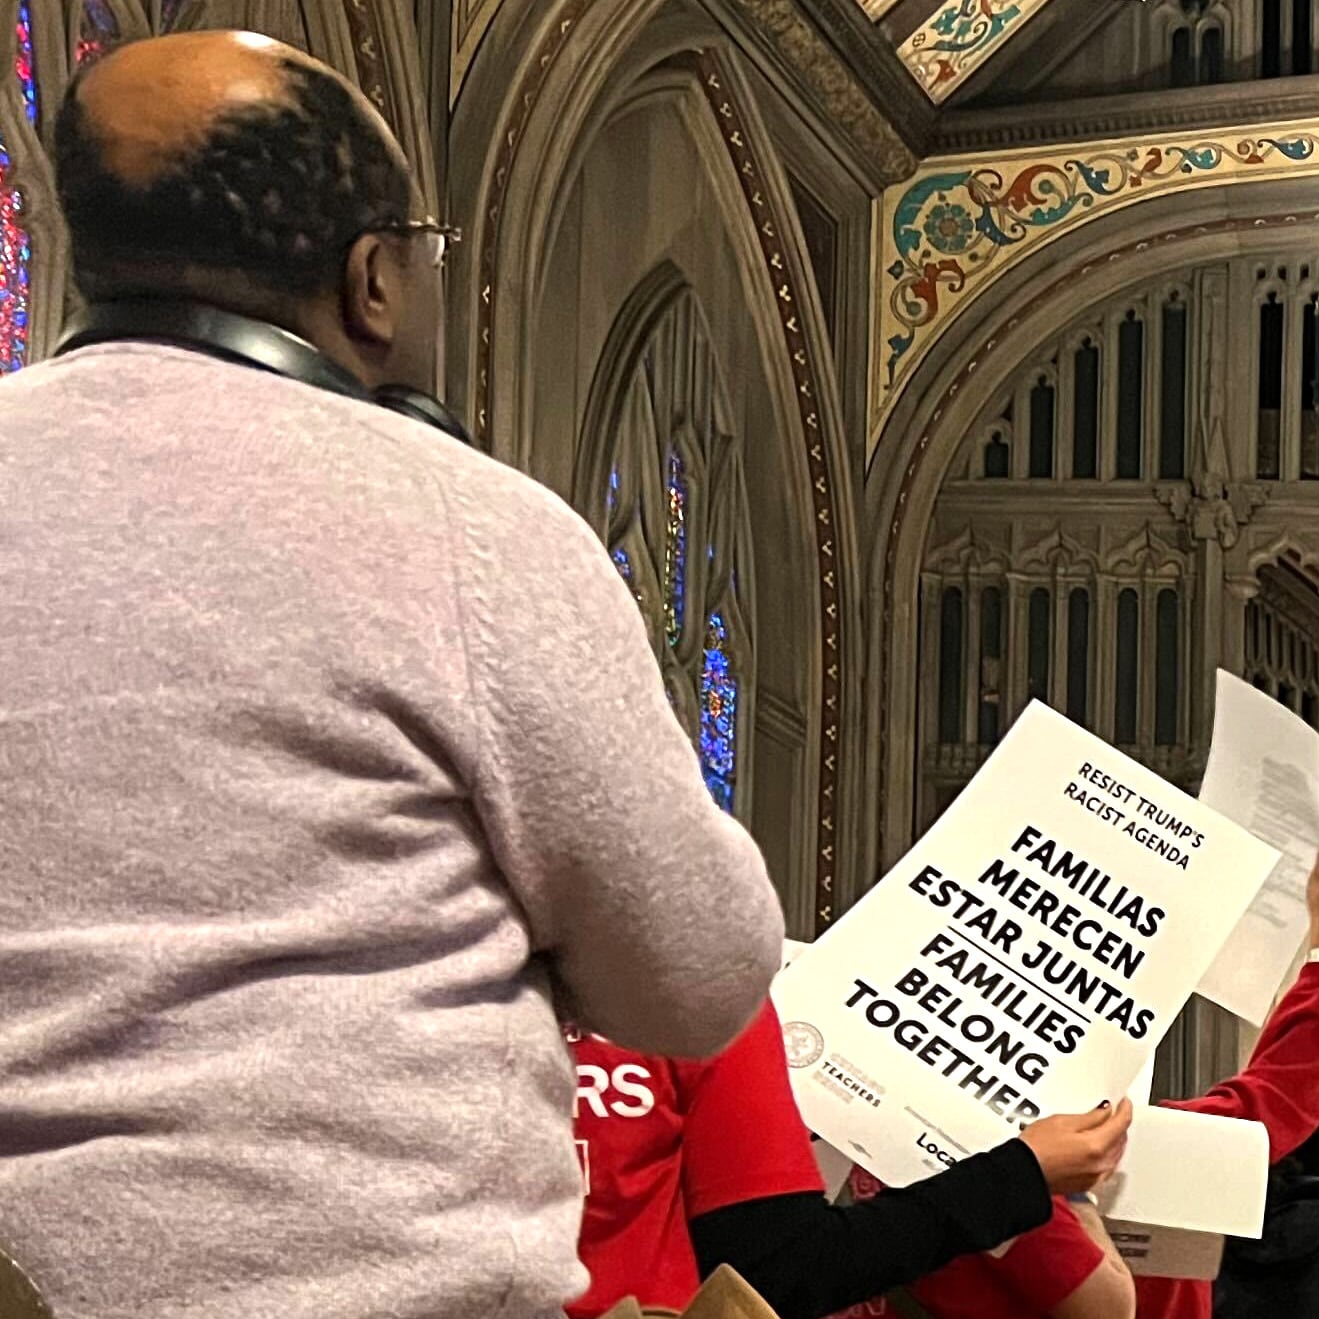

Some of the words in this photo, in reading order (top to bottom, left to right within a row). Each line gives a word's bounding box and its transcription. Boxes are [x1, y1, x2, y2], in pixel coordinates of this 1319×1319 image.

[1064, 782, 1126, 826] RACIST
[1122, 821, 1189, 870] AGENDA
[1078, 762, 1137, 803] RESIST
[1136, 796, 1205, 848] TRUMP'S
[978, 859, 1145, 979] MERECEN
[1010, 825, 1166, 937] FAMILIAS
[908, 865, 1023, 954] ESTAR
[1021, 940, 1155, 1039] JUNTAS
[919, 933, 1085, 1054] FAMILIES
[845, 978, 1040, 1131] TOGETHER
[894, 967, 1049, 1085] BELONG
[572, 1064, 655, 1118] RS
[822, 1062, 881, 1108] TEACHERS
